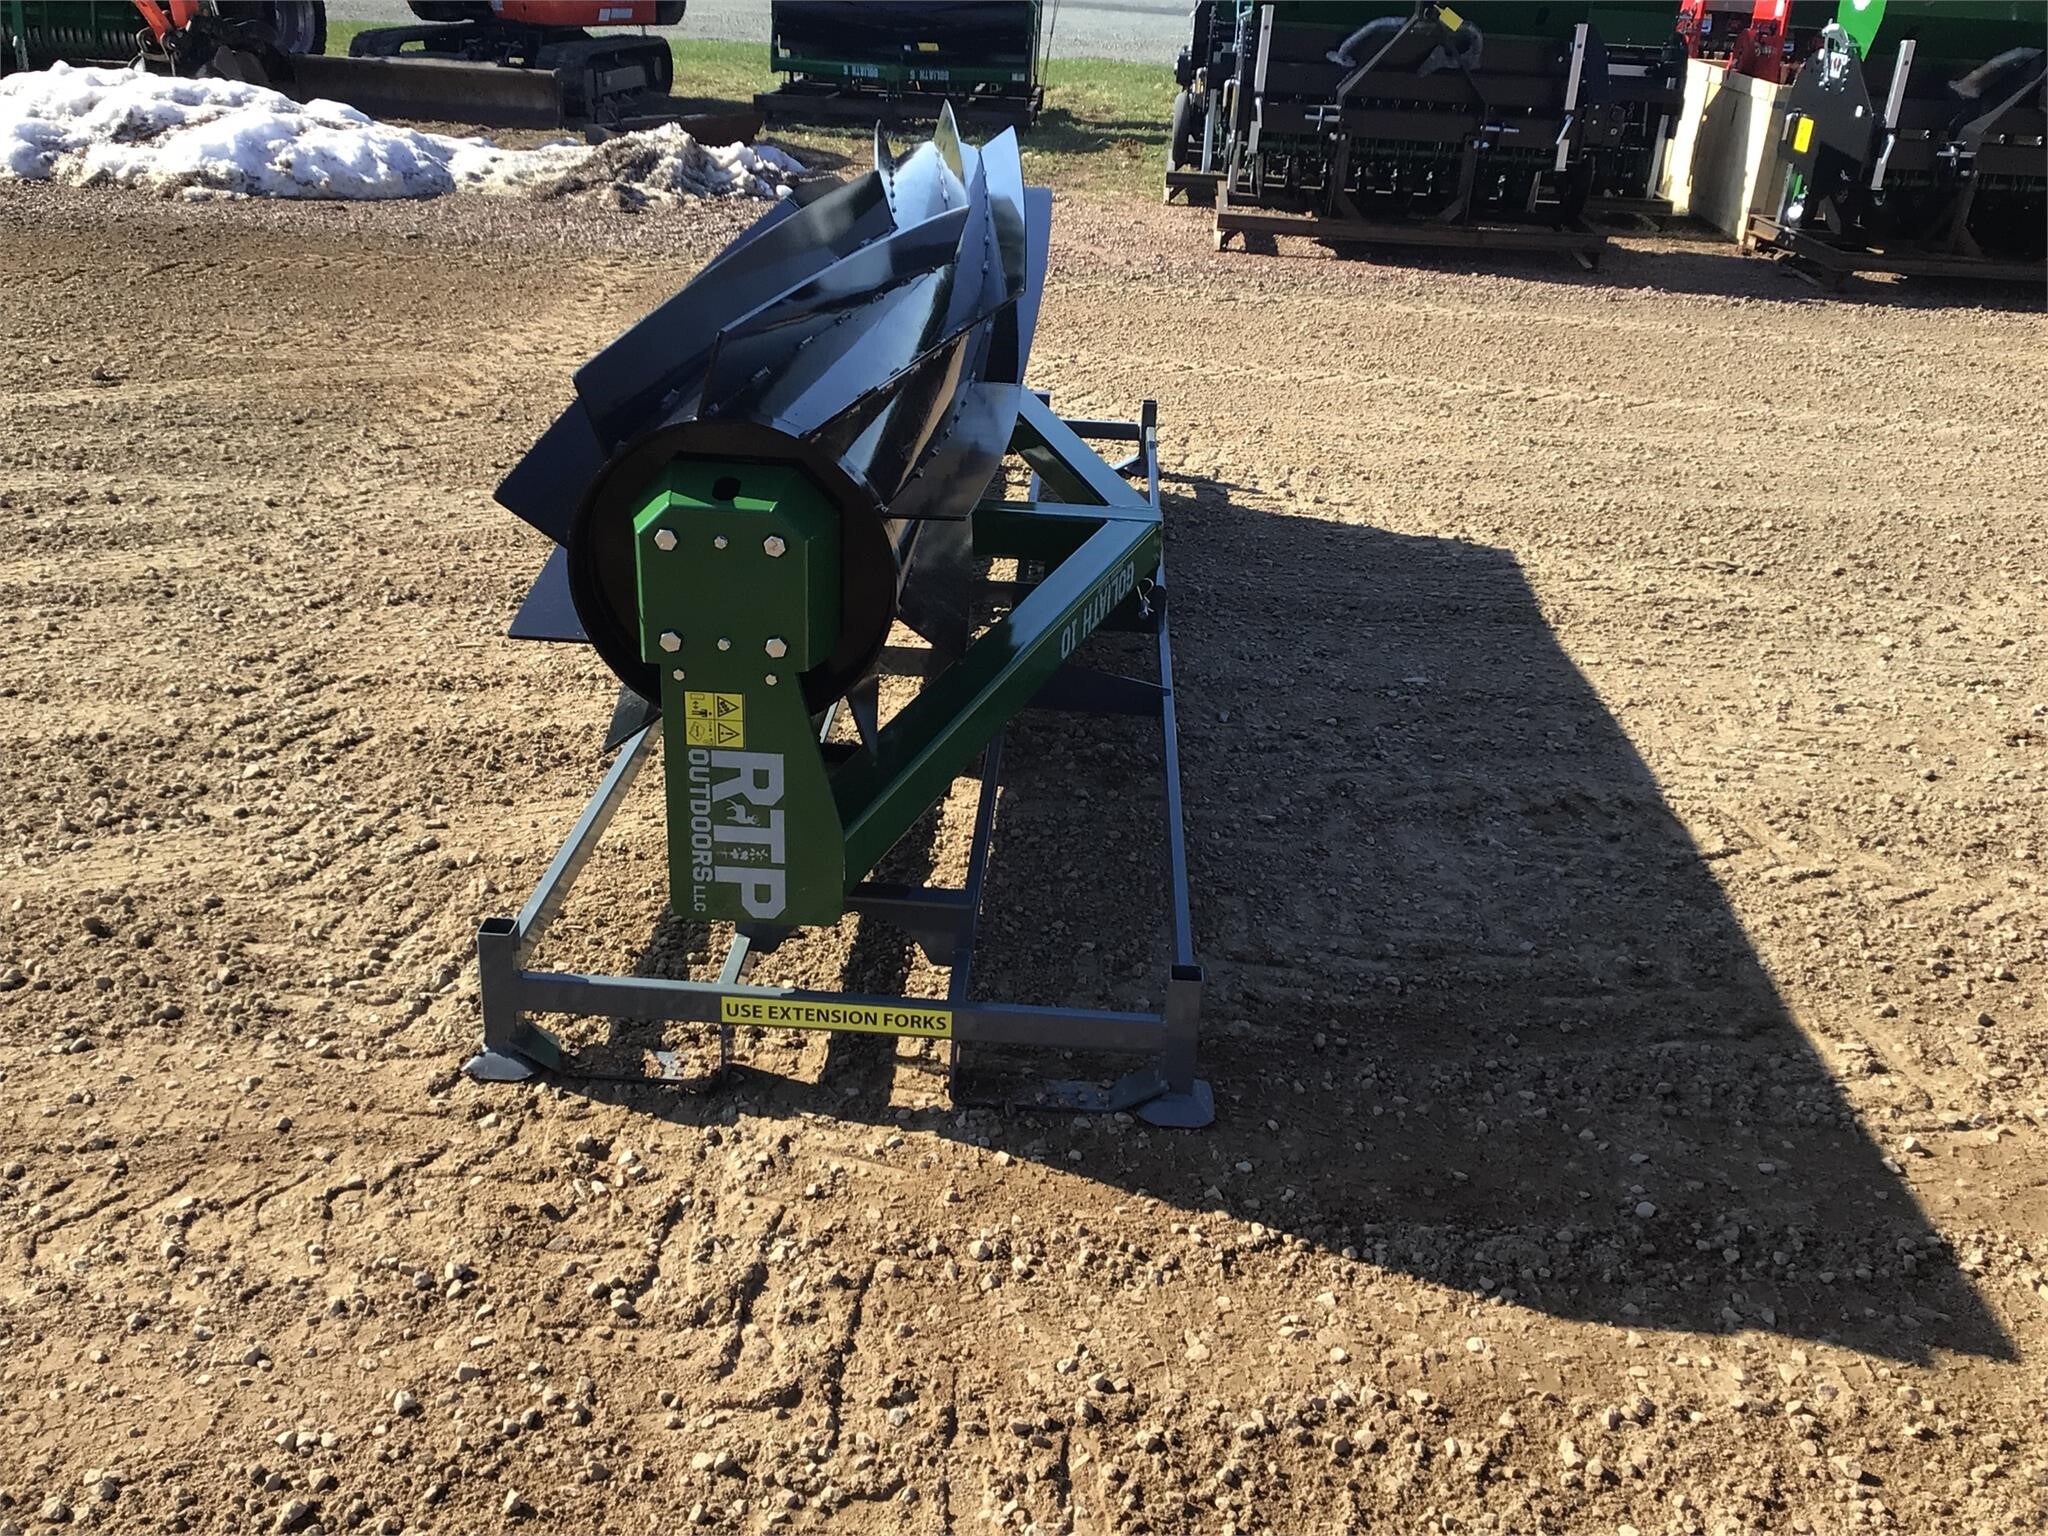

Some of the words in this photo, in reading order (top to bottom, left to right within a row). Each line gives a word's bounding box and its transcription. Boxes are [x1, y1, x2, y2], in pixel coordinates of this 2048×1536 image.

[1082, 561, 1134, 640] GOLIATH
[1061, 618, 1077, 660] 10
[688, 748, 713, 882] OUTDOORS
[711, 750, 786, 919] RTP
[693, 885, 706, 912] LLC
[726, 1003, 762, 1018] USE
[768, 1005, 878, 1027] EXTENSION
[883, 1013, 947, 1030] FORKS
